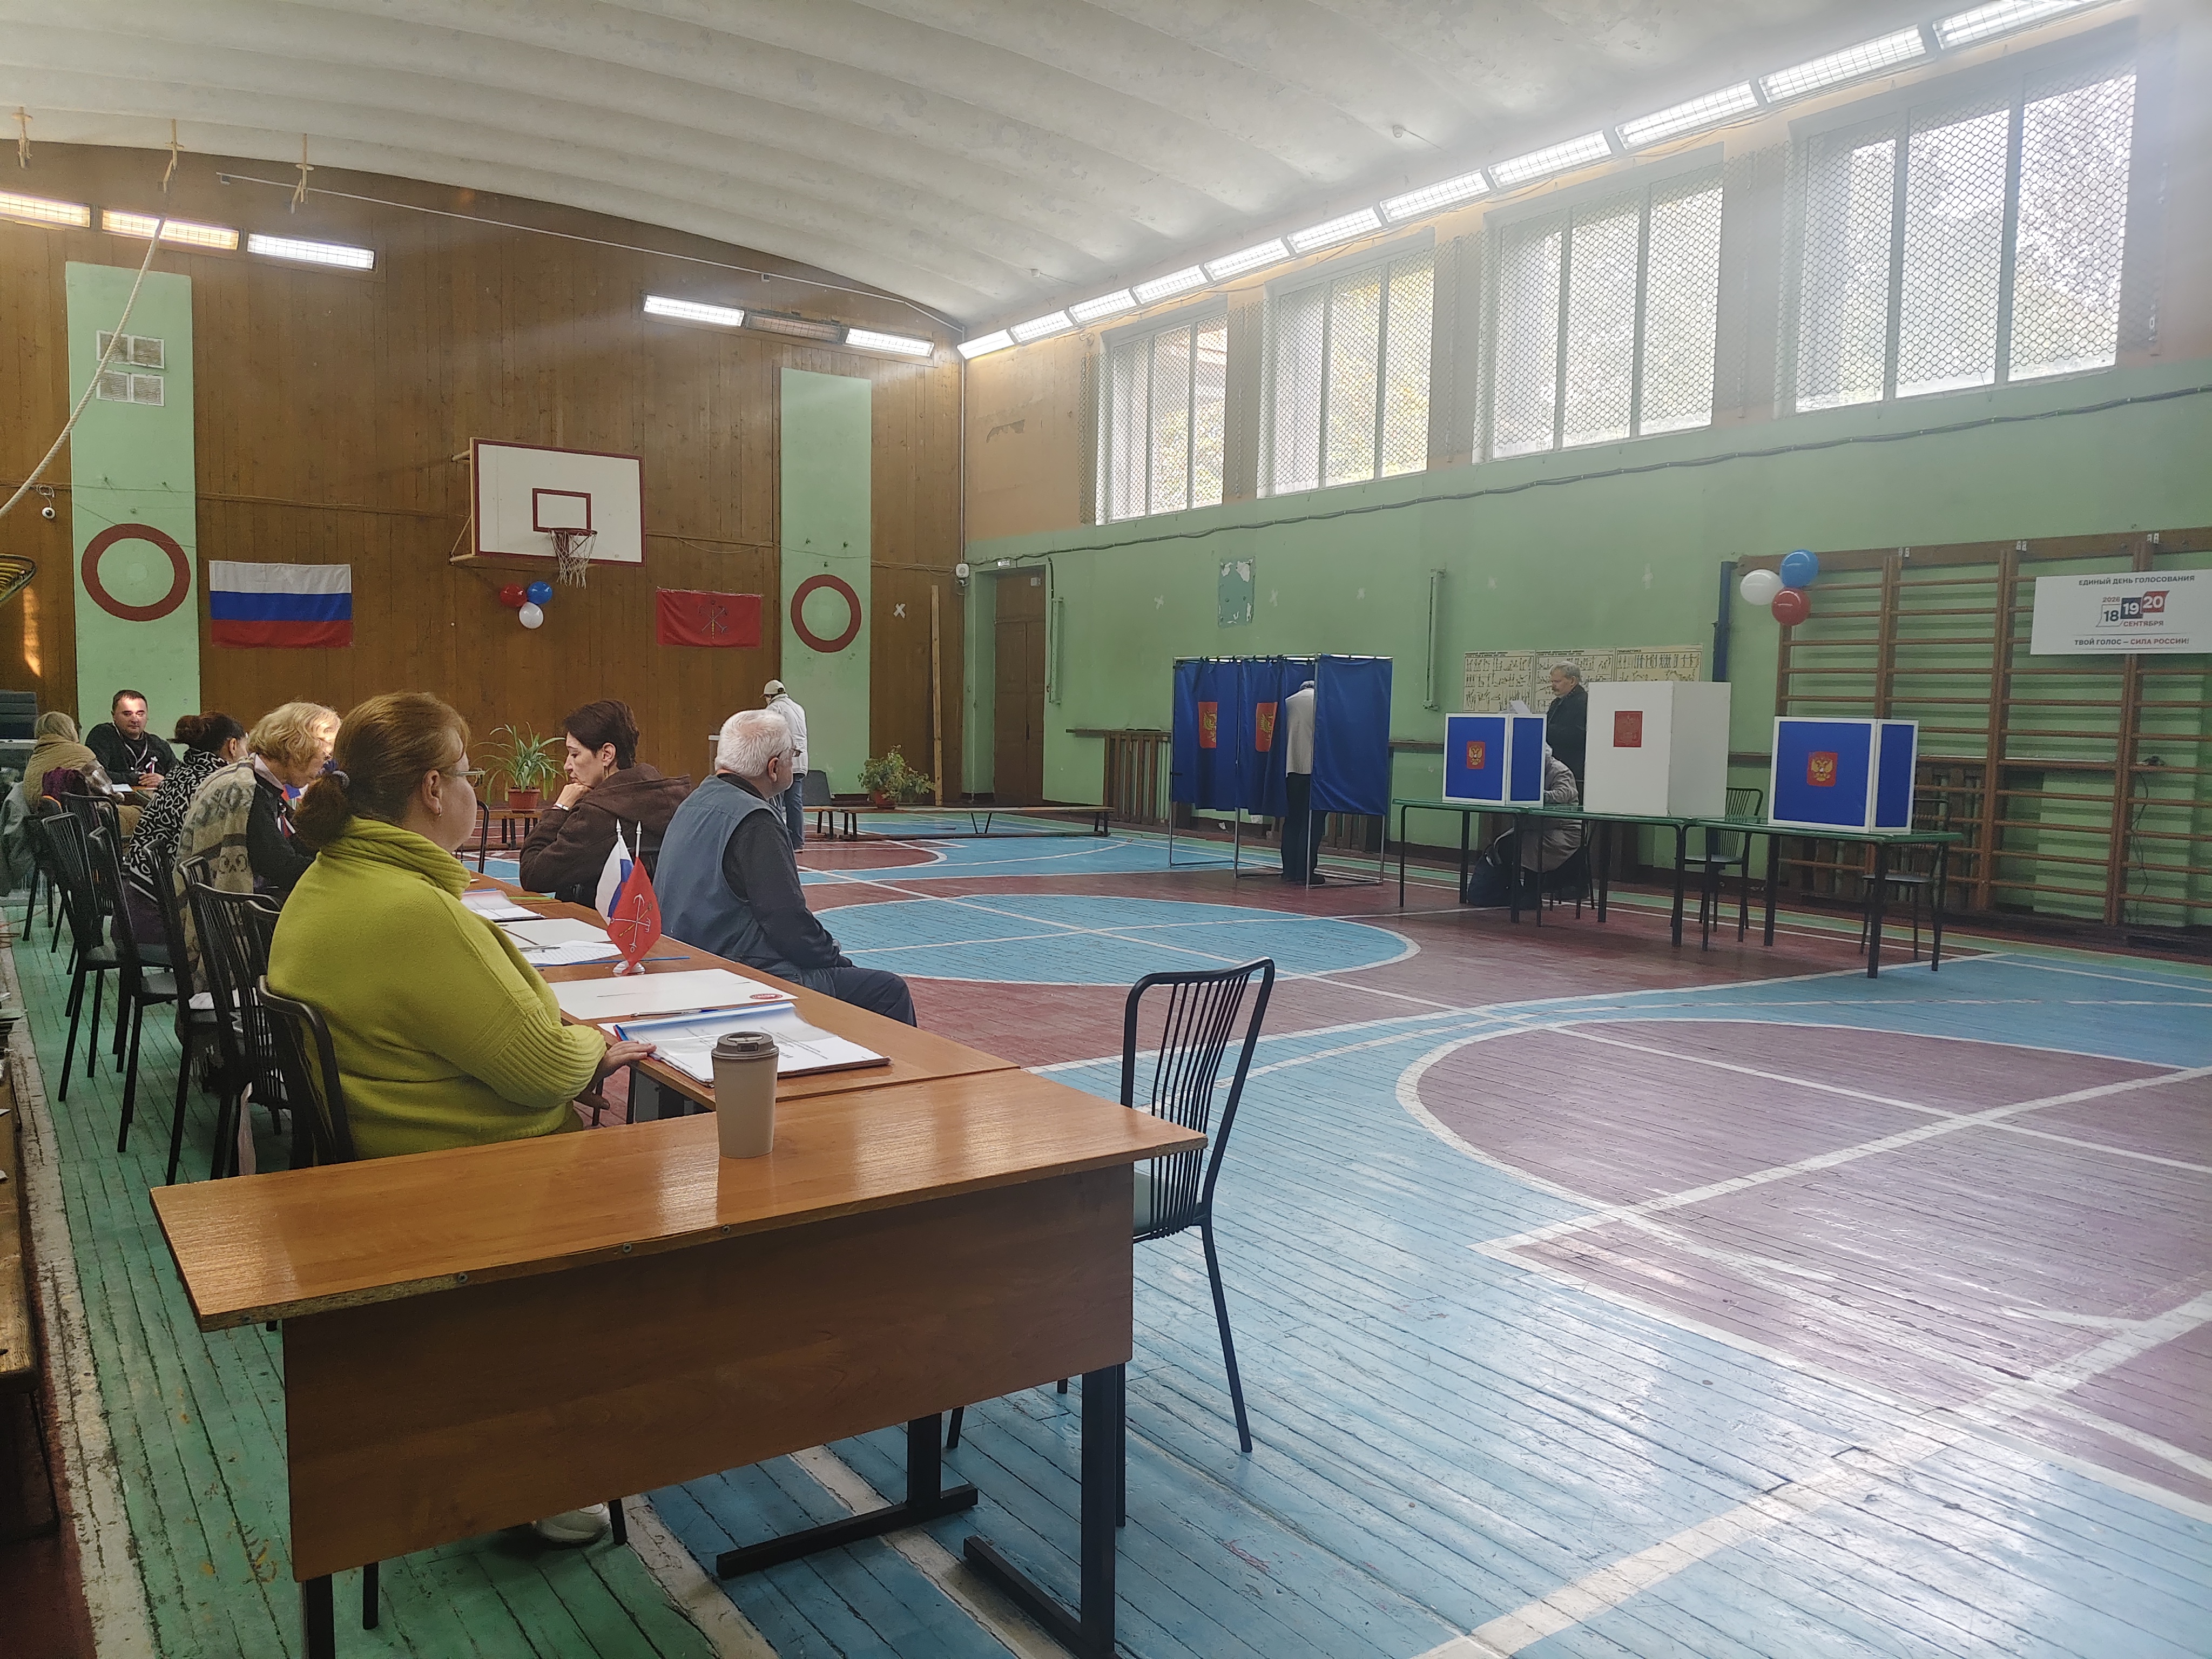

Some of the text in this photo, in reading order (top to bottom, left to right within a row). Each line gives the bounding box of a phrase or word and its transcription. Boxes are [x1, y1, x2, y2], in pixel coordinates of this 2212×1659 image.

[2079, 577, 2110, 585] ЕДИНЫЙ
[2103, 596, 2163, 622] 18 19 20
